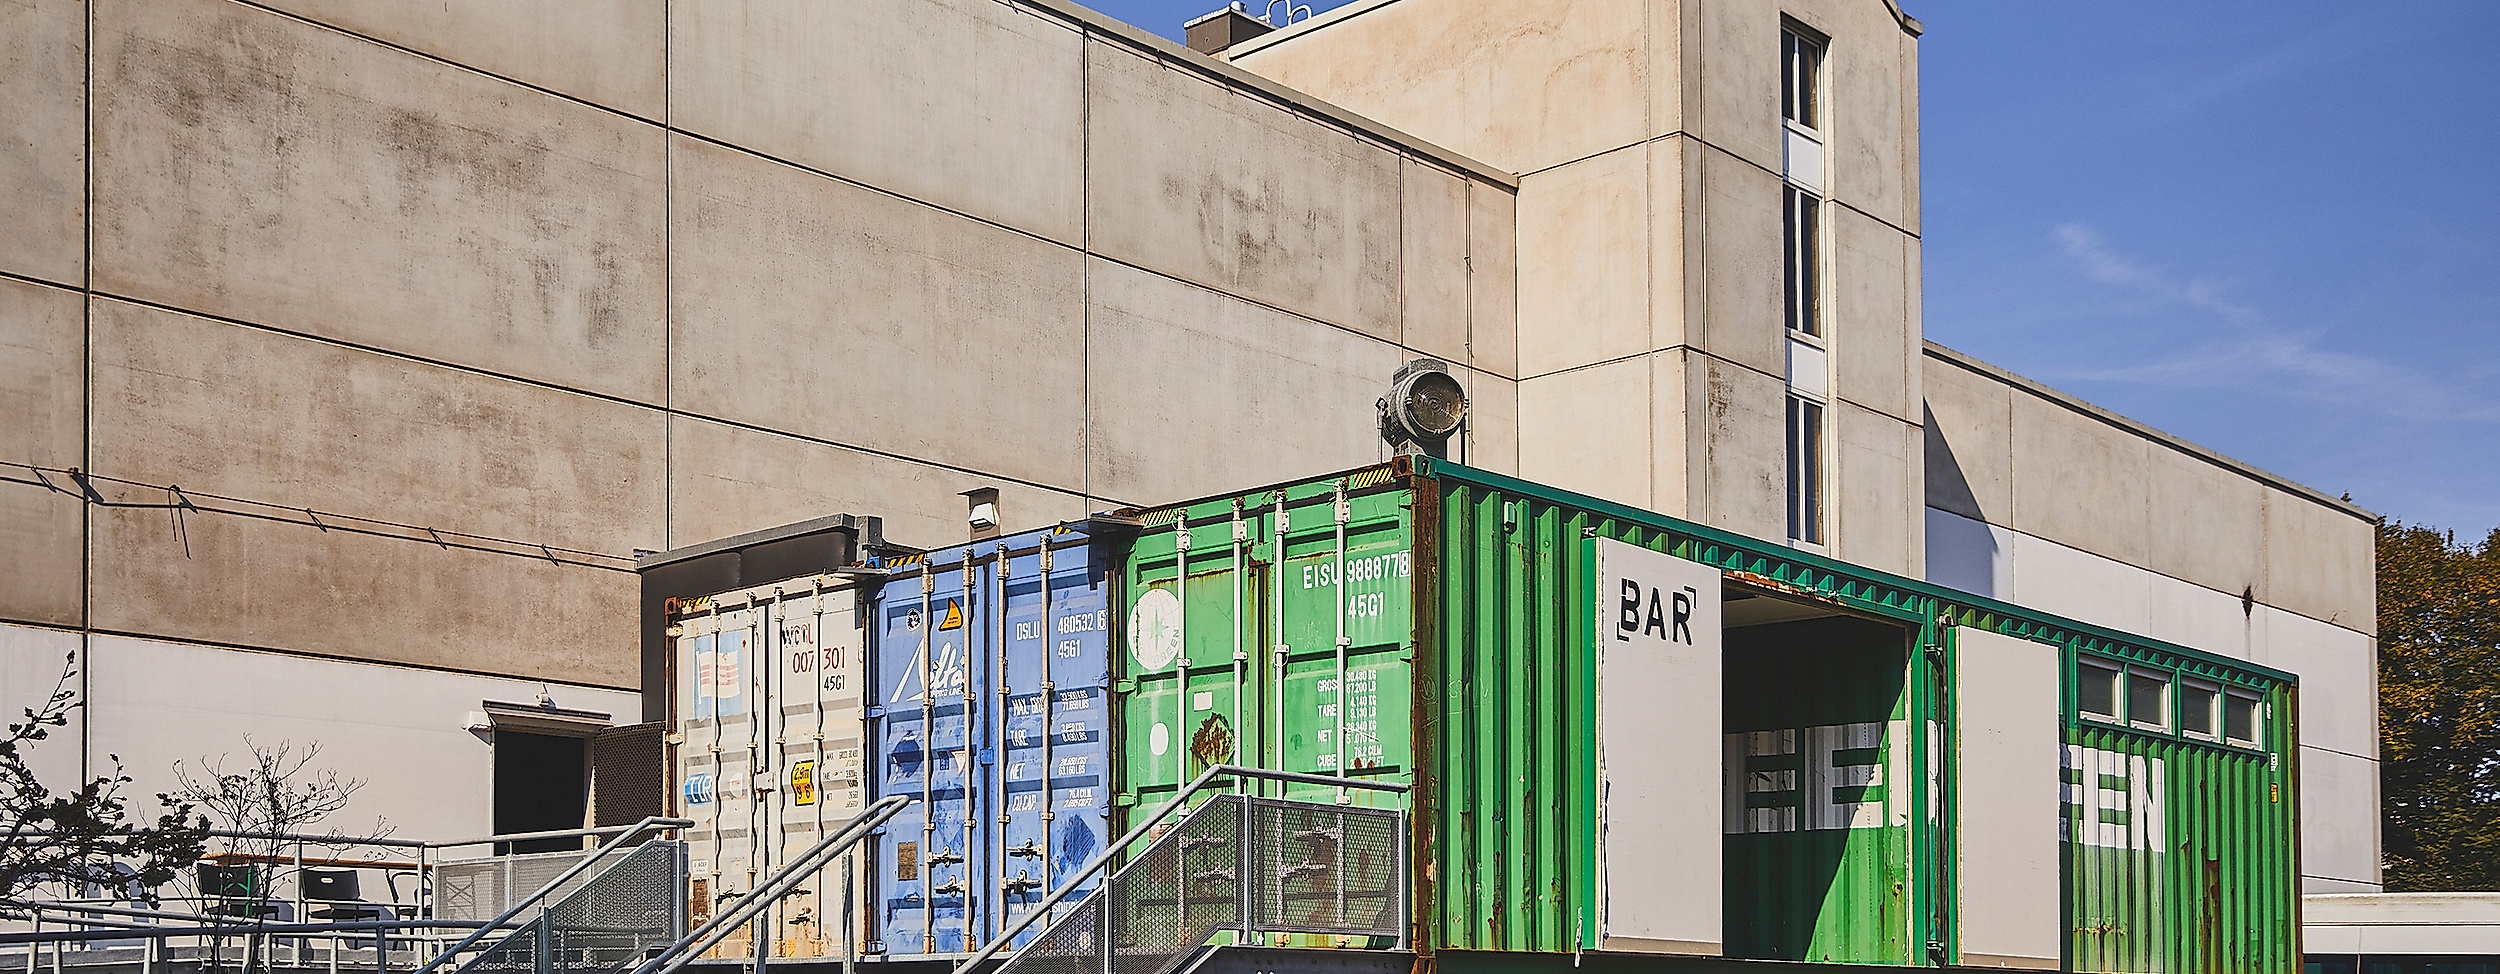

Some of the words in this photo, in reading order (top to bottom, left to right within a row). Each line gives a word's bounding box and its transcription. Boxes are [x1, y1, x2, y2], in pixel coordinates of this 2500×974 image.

[1303, 562, 1337, 589] EISU
[1348, 592, 1384, 619] 45G1
[1620, 577, 1693, 646] BAR
[1016, 621, 1040, 640] DSLU
[1057, 613, 1094, 634] 480532
[1057, 639, 1081, 658] 45G1
[793, 650, 814, 674] 007
[823, 646, 845, 670] 301
[824, 675, 845, 691] 45G1
[1317, 679, 1337, 692] GROS
[1368, 681, 1376, 691] LB
[1030, 696, 1044, 713] GRO
[1368, 695, 1377, 705] KG
[1317, 704, 1337, 717] TARE
[1368, 706, 1376, 717] LB
[1368, 720, 1377, 731] KG
[1010, 729, 1028, 746] TARE
[1318, 729, 1332, 743] NET
[1346, 732, 1367, 744] 5.070
[1317, 754, 1337, 767] CUBE
[1010, 763, 1025, 780] NET
[690, 775, 713, 802] TIR
